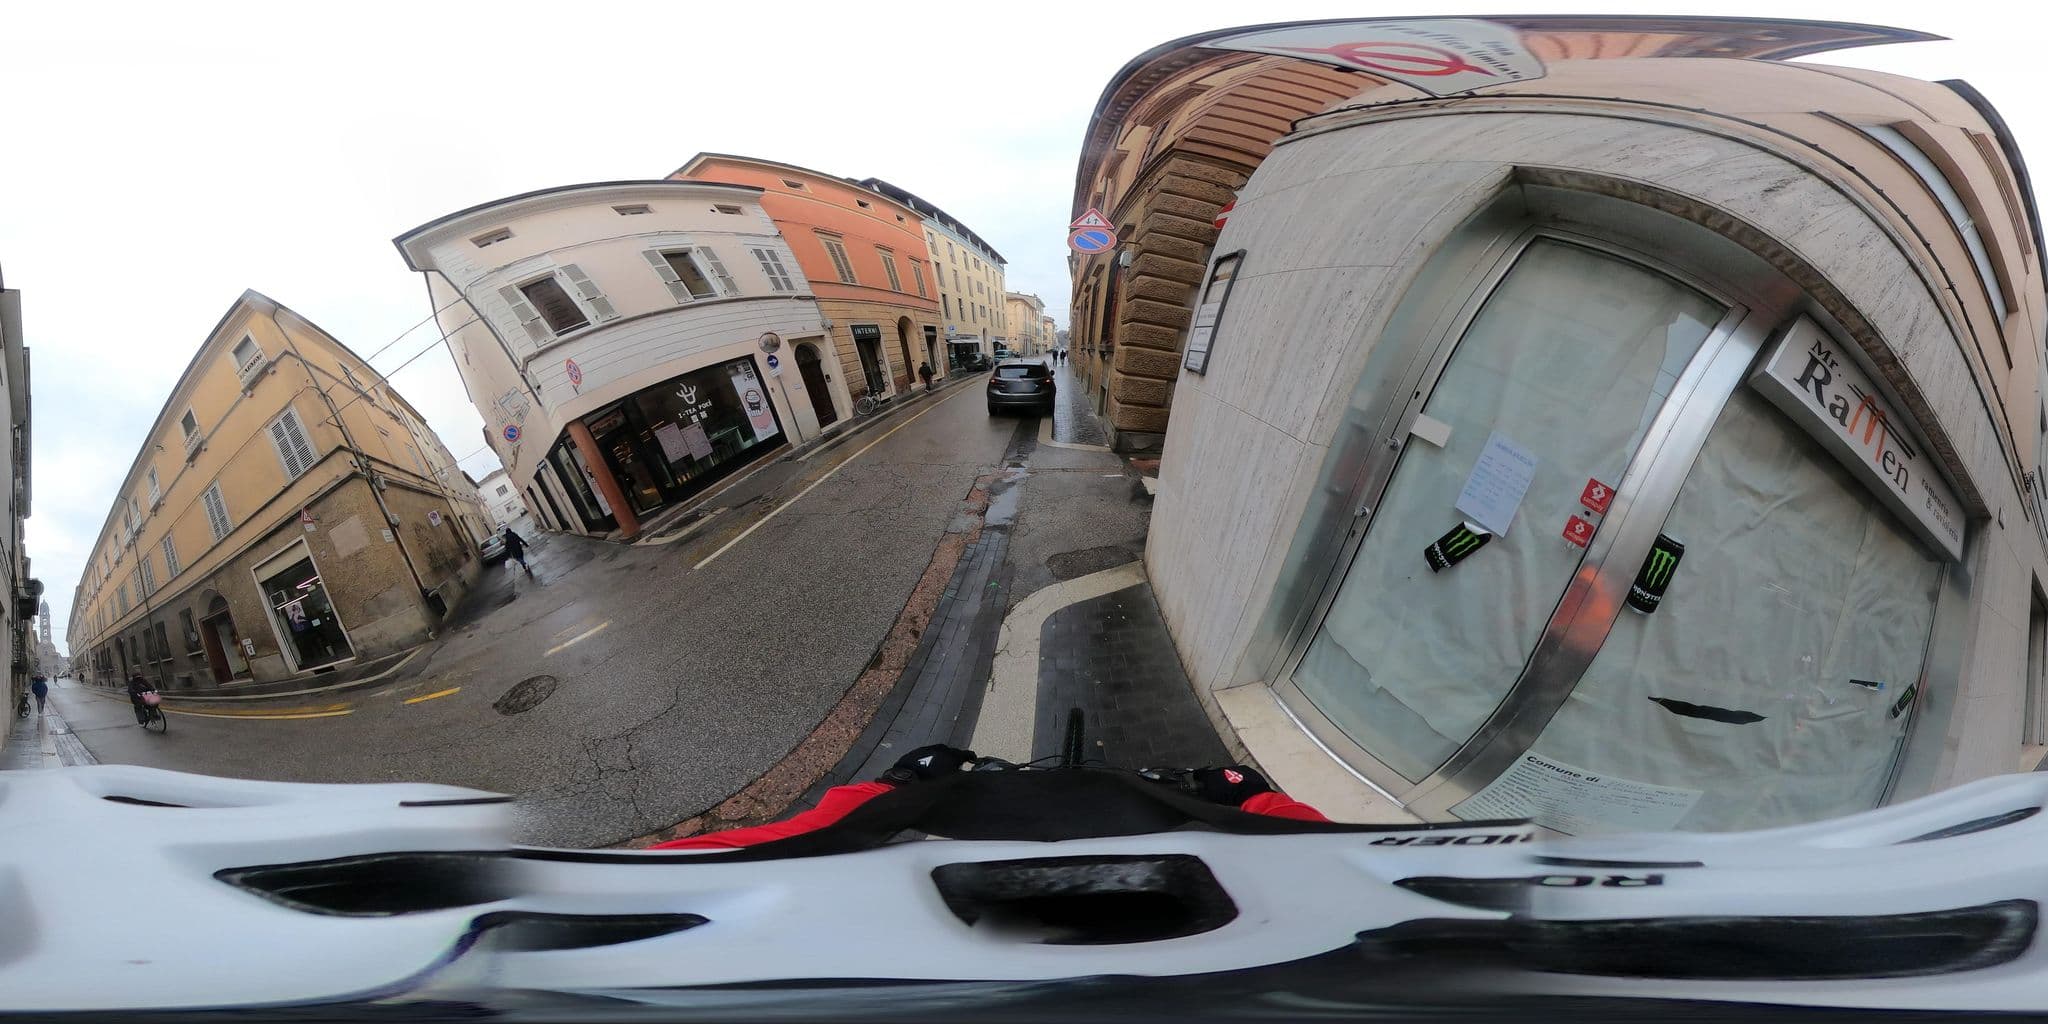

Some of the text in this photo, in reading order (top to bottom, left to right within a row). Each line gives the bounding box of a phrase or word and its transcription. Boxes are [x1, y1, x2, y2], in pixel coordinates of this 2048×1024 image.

[1466, 50, 1522, 79] limitato
[1810, 340, 1841, 377] Mr.
[1526, 755, 1600, 783] Comune di
